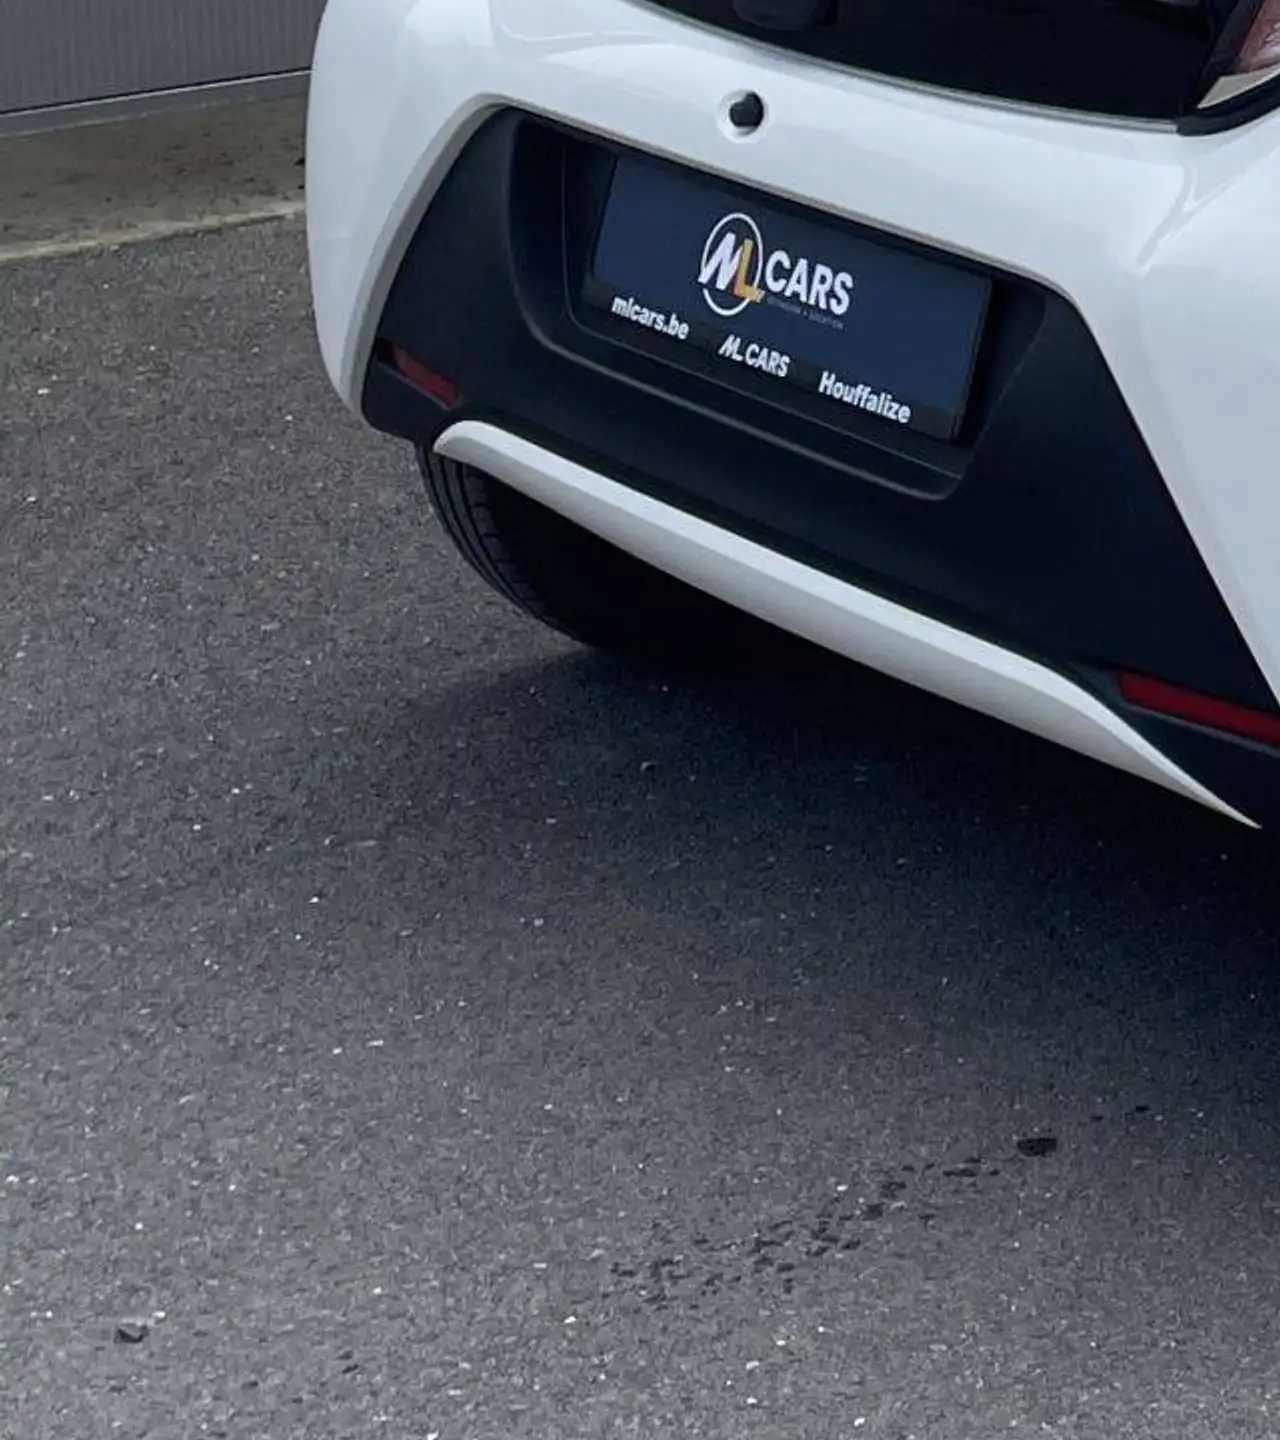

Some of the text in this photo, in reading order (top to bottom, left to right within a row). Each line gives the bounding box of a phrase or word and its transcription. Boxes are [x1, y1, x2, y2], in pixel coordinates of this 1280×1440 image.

[765, 249, 855, 316] CARS
[611, 295, 690, 340] mlcars.be
[743, 343, 791, 378] CARS
[818, 370, 911, 424] Houffalize
